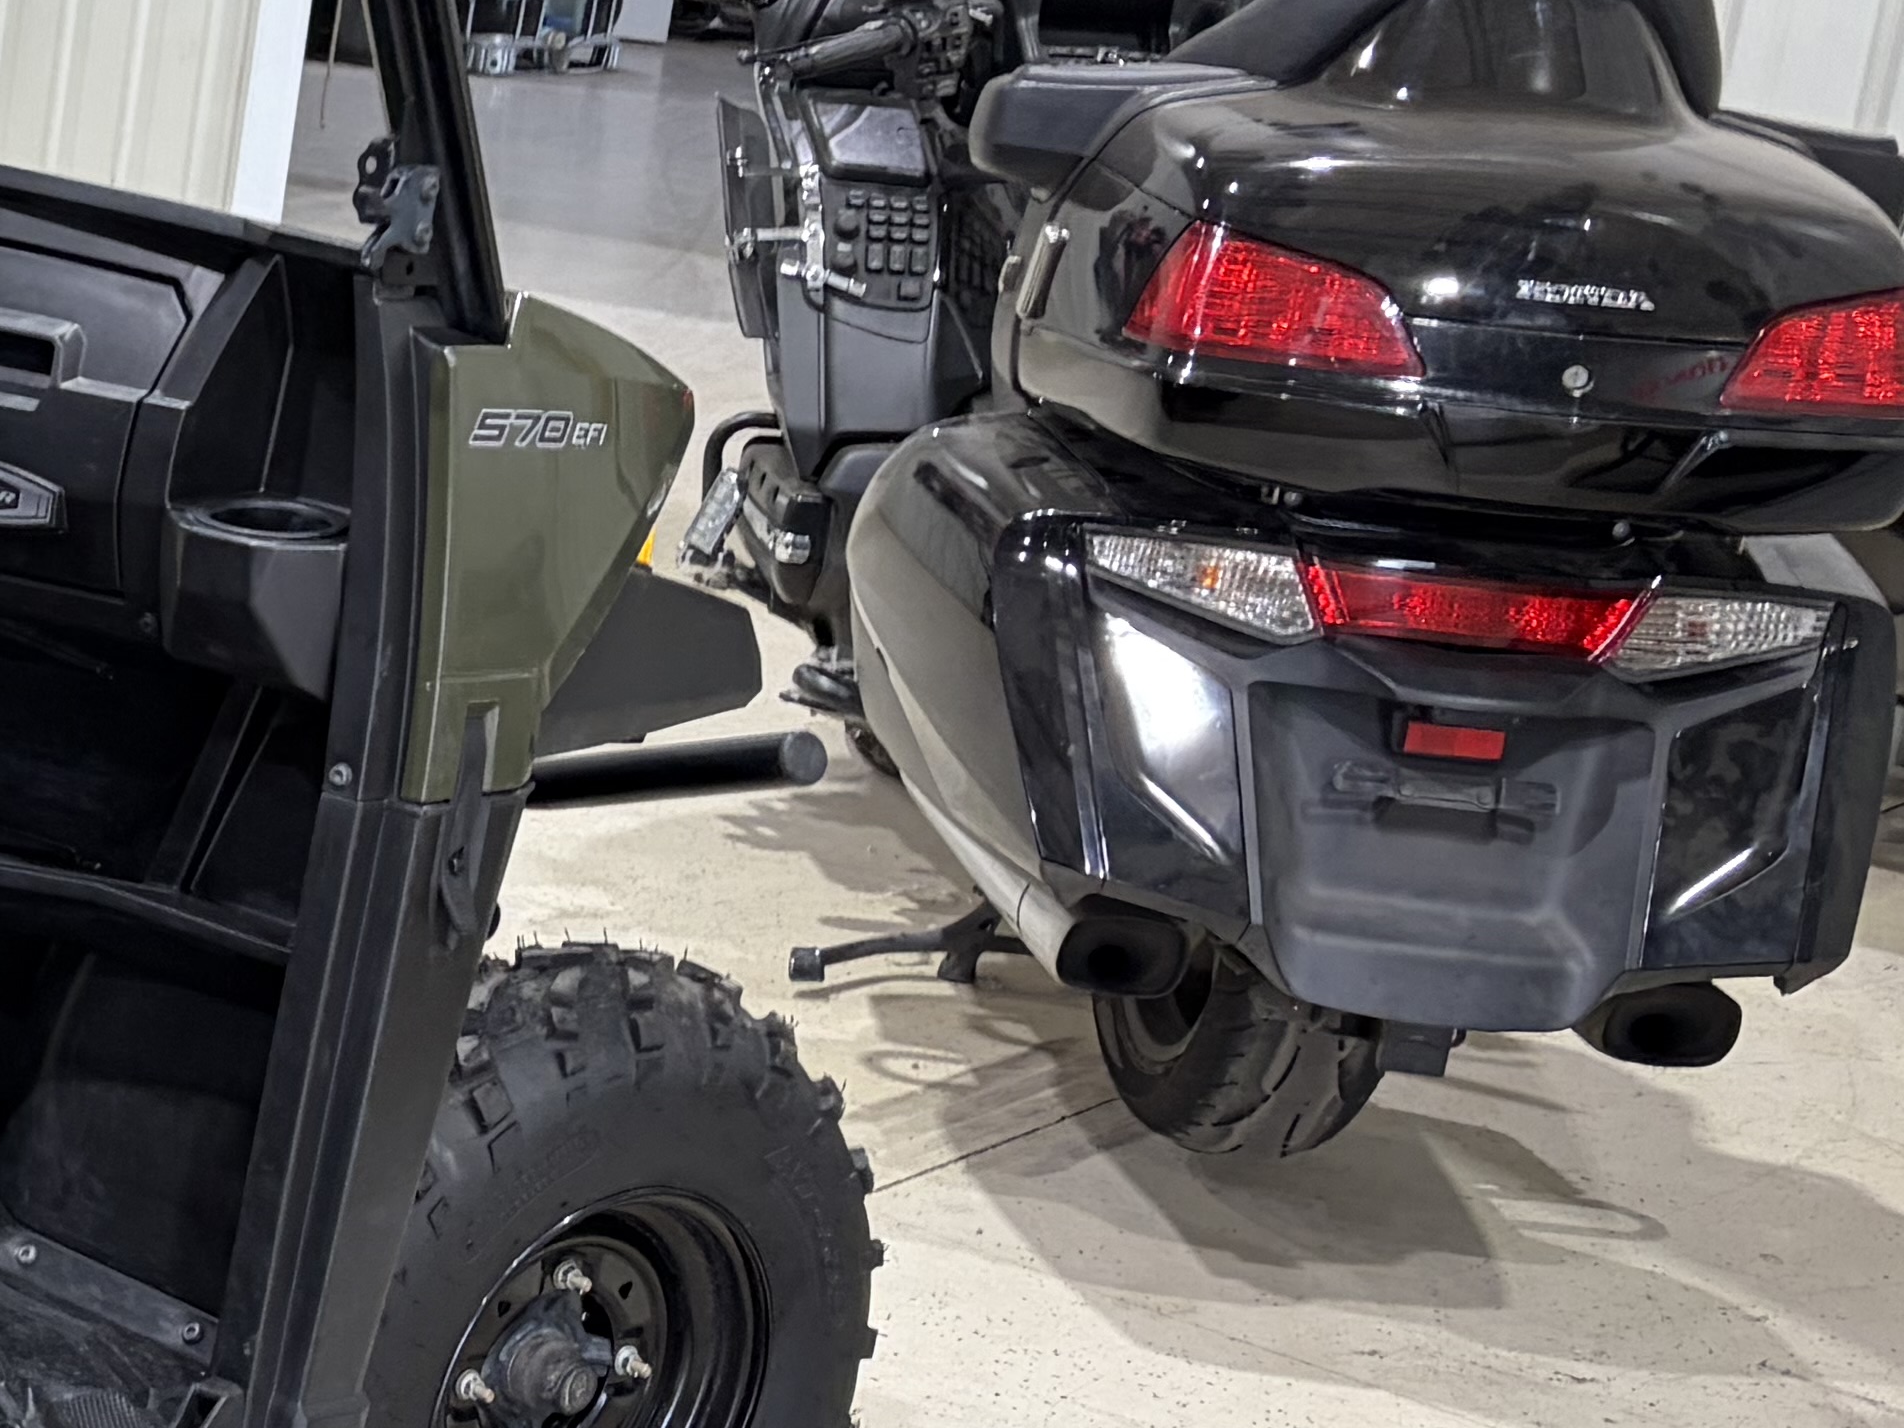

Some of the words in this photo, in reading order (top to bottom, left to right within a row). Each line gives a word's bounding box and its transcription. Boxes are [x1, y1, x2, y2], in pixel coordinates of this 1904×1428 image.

[1515, 278, 1656, 312] HONDA
[468, 408, 574, 448] 570
[571, 421, 608, 448] EFI
